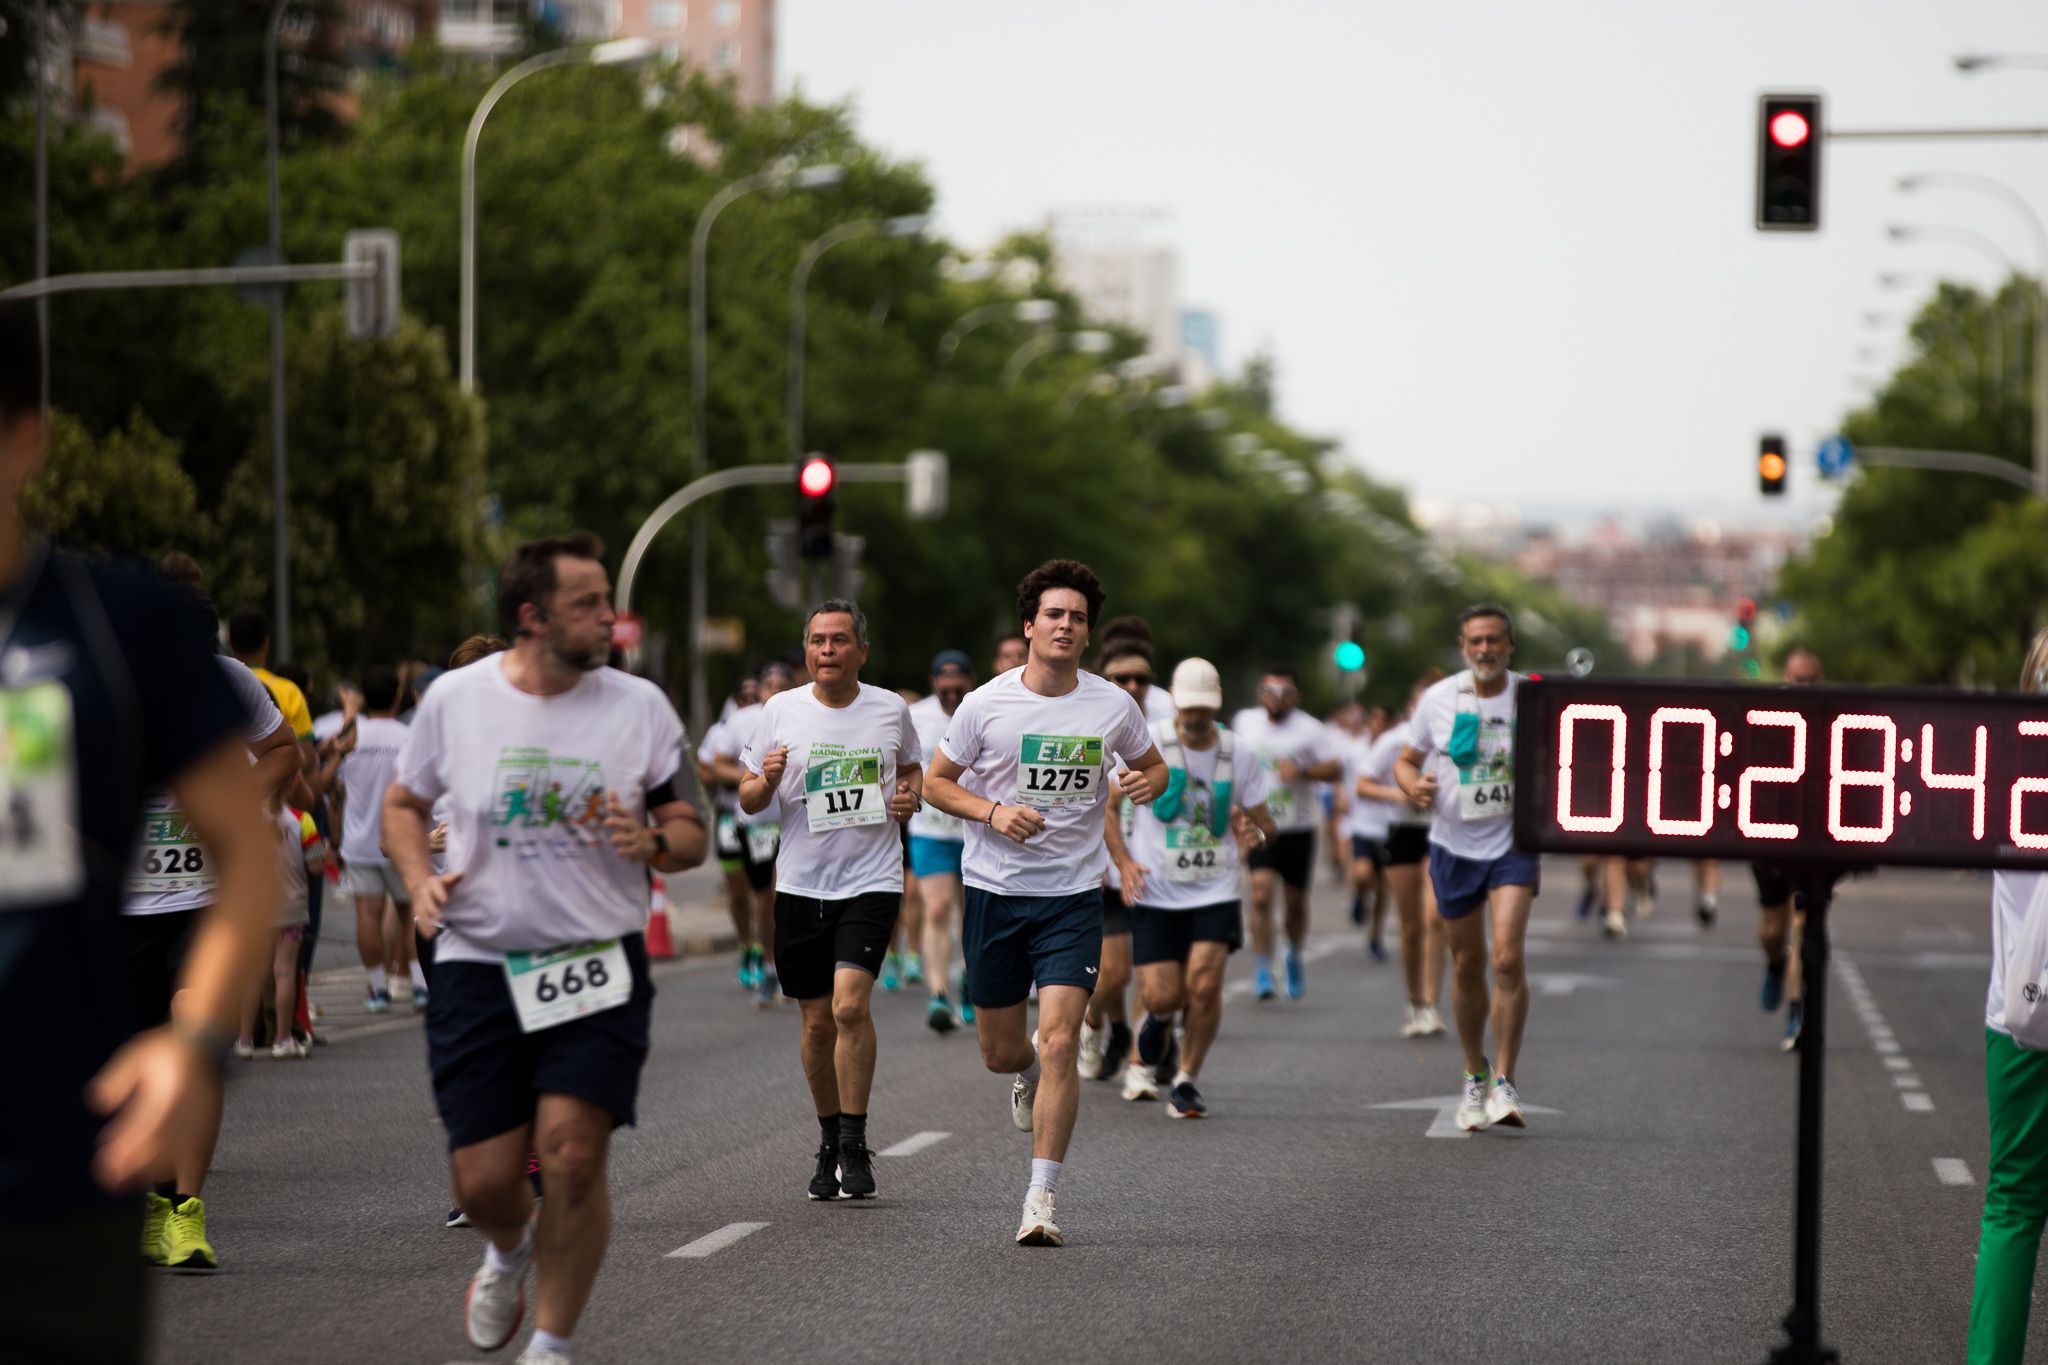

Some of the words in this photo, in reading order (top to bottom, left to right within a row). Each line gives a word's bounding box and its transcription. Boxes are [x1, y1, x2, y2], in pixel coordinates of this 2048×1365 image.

[810, 749, 847, 757] MADRID
[848, 747, 869, 757] CON
[871, 746, 882, 754] LA
[1037, 741, 1085, 763] ELA
[821, 763, 863, 787] ELA
[1027, 767, 1090, 791] 1275
[825, 788, 864, 814] 117
[142, 847, 203, 874] 628
[1177, 850, 1216, 868] 642
[536, 957, 609, 1002] 668
